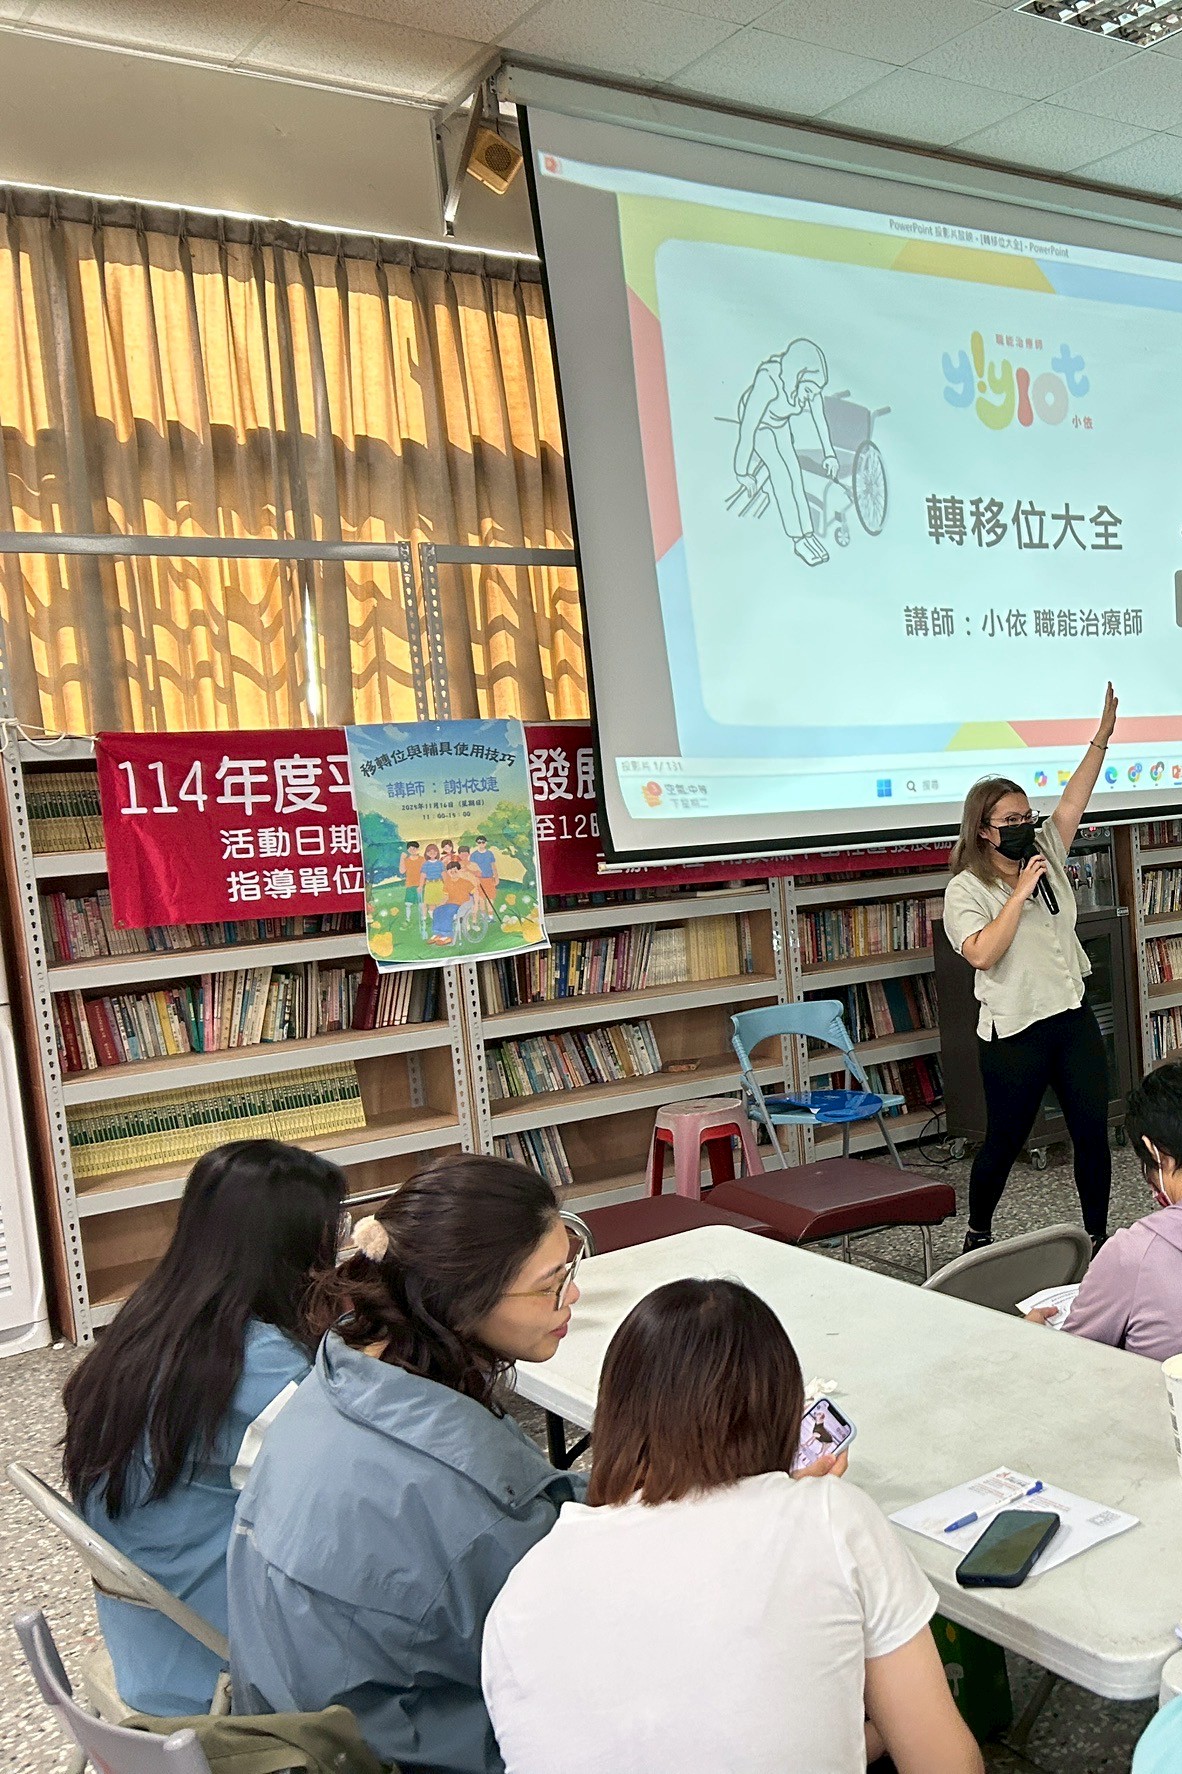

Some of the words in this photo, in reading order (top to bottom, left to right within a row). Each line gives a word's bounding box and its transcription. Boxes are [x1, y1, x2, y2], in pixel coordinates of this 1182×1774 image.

[889, 218, 934, 236] PowerPoint
[1029, 242, 1069, 258] PowerPoint
[1071, 414, 1094, 430] 小依
[925, 493, 1123, 551] 轉移位大全
[1034, 608, 1144, 638] 職能治療師
[360, 741, 516, 778] 移轉位與輔具使用技巧
[219, 824, 361, 860] 活動日期
[226, 864, 365, 903] 指導單位
